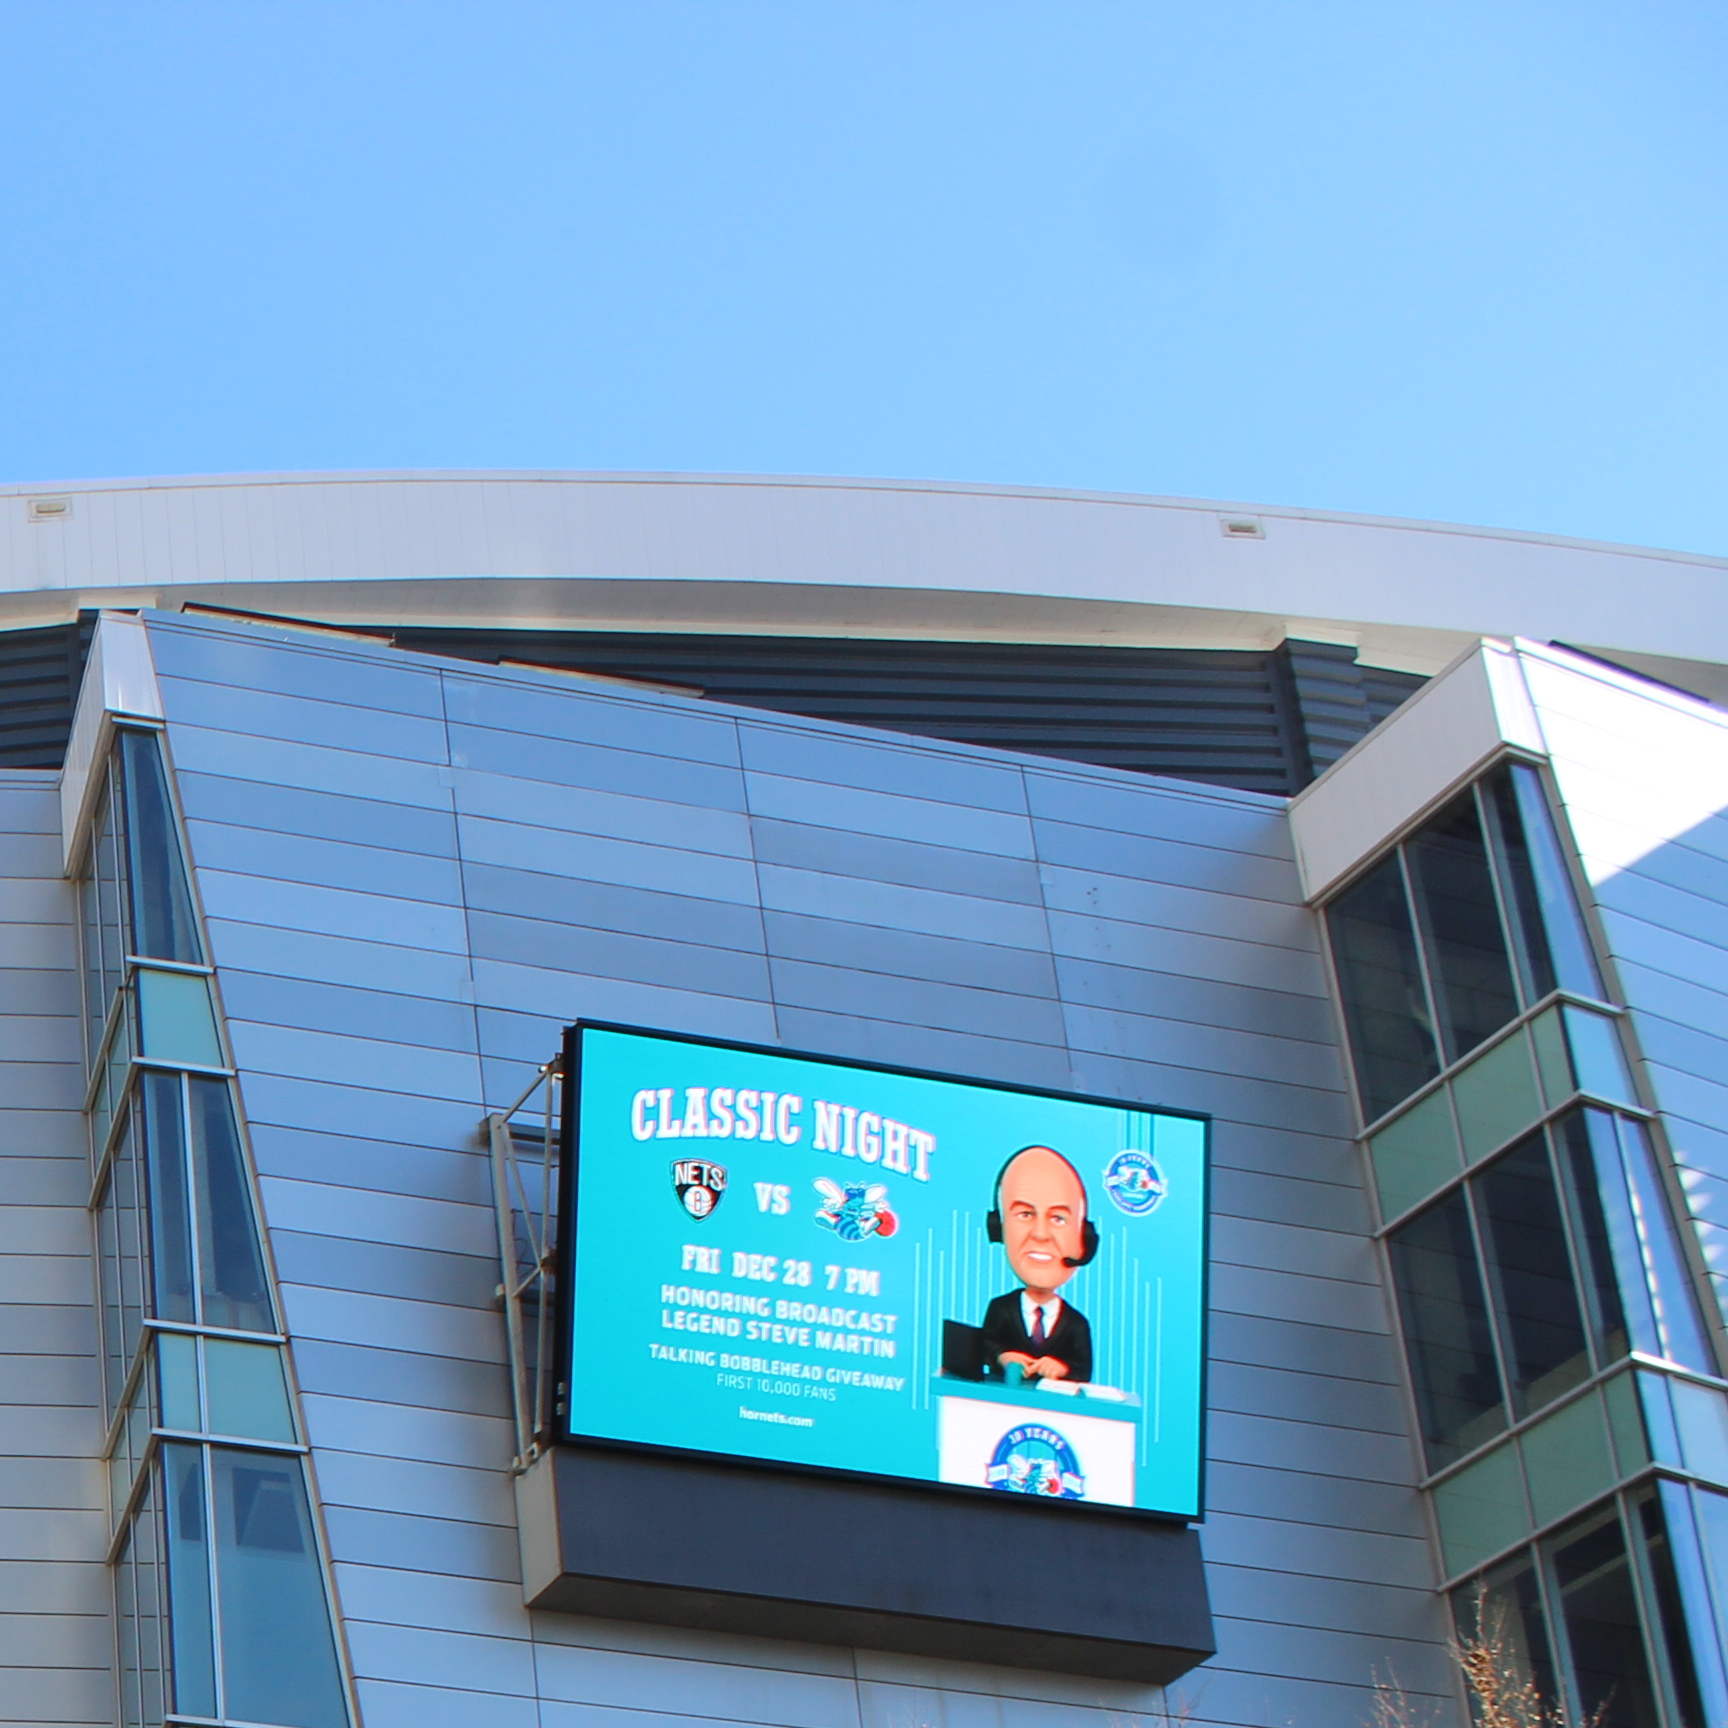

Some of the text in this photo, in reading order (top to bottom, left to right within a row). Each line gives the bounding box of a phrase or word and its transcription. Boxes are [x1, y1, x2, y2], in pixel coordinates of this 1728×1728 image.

[631, 1086, 936, 1182] CLASSIC NIGHT
[675, 1162, 723, 1192] NETS
[753, 1181, 791, 1215] VS
[681, 1244, 881, 1297] FRI DEC 28 7 PM
[660, 1284, 898, 1334] HONORING BROADCAST
[661, 1308, 897, 1359] LEGEND STEVE MARTIN
[649, 1343, 906, 1392] TALKING BOBBLEHEAD GIVEAWAY
[716, 1373, 837, 1402] FIRST 10,000 FANS
[739, 1405, 815, 1427] hornets.com
